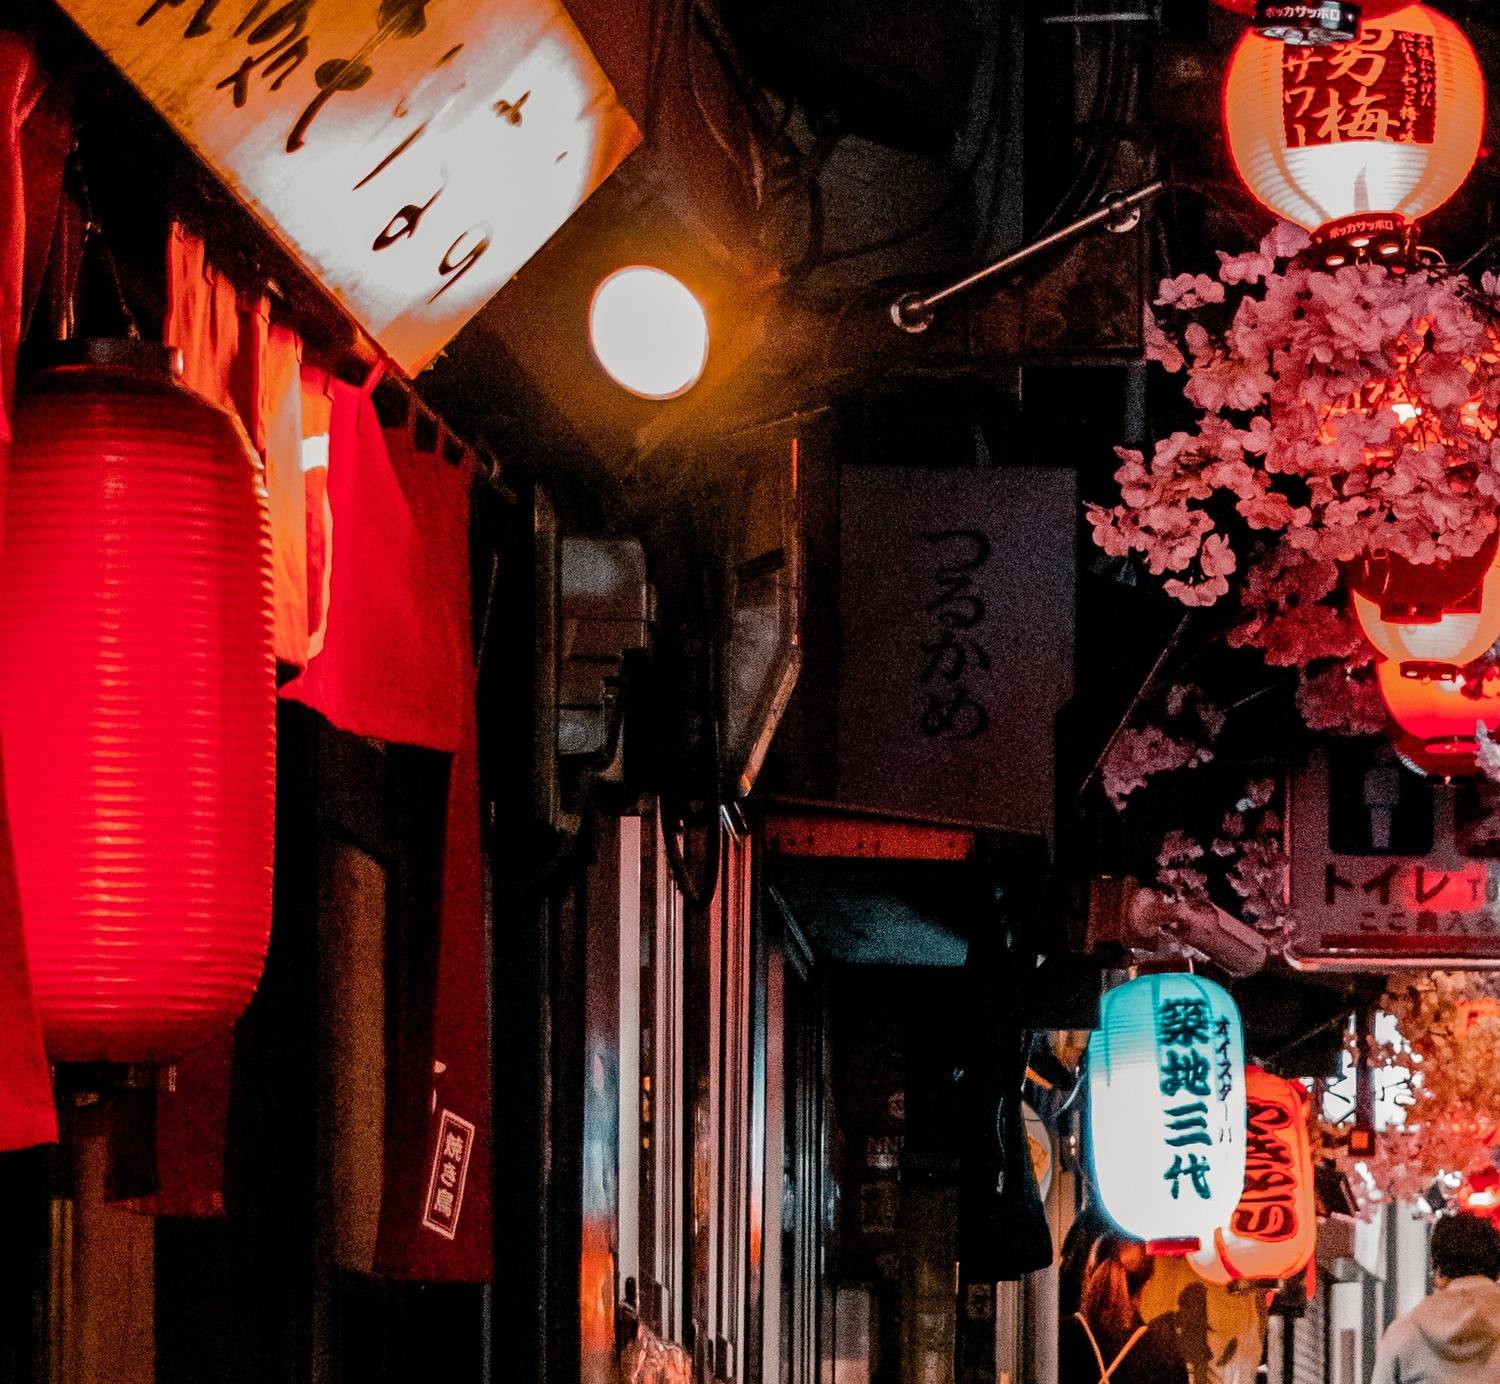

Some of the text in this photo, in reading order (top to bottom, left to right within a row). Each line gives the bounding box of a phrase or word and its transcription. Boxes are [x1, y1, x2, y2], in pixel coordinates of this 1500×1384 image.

[1282, 45, 1324, 147] サワー
[1311, 29, 1401, 143] 男梅
[1329, 220, 1394, 239] ポッカサッポロ
[914, 529, 991, 739] つるかめ
[1324, 863, 1448, 905] トイレ
[1159, 997, 1213, 1200] 築地三代
